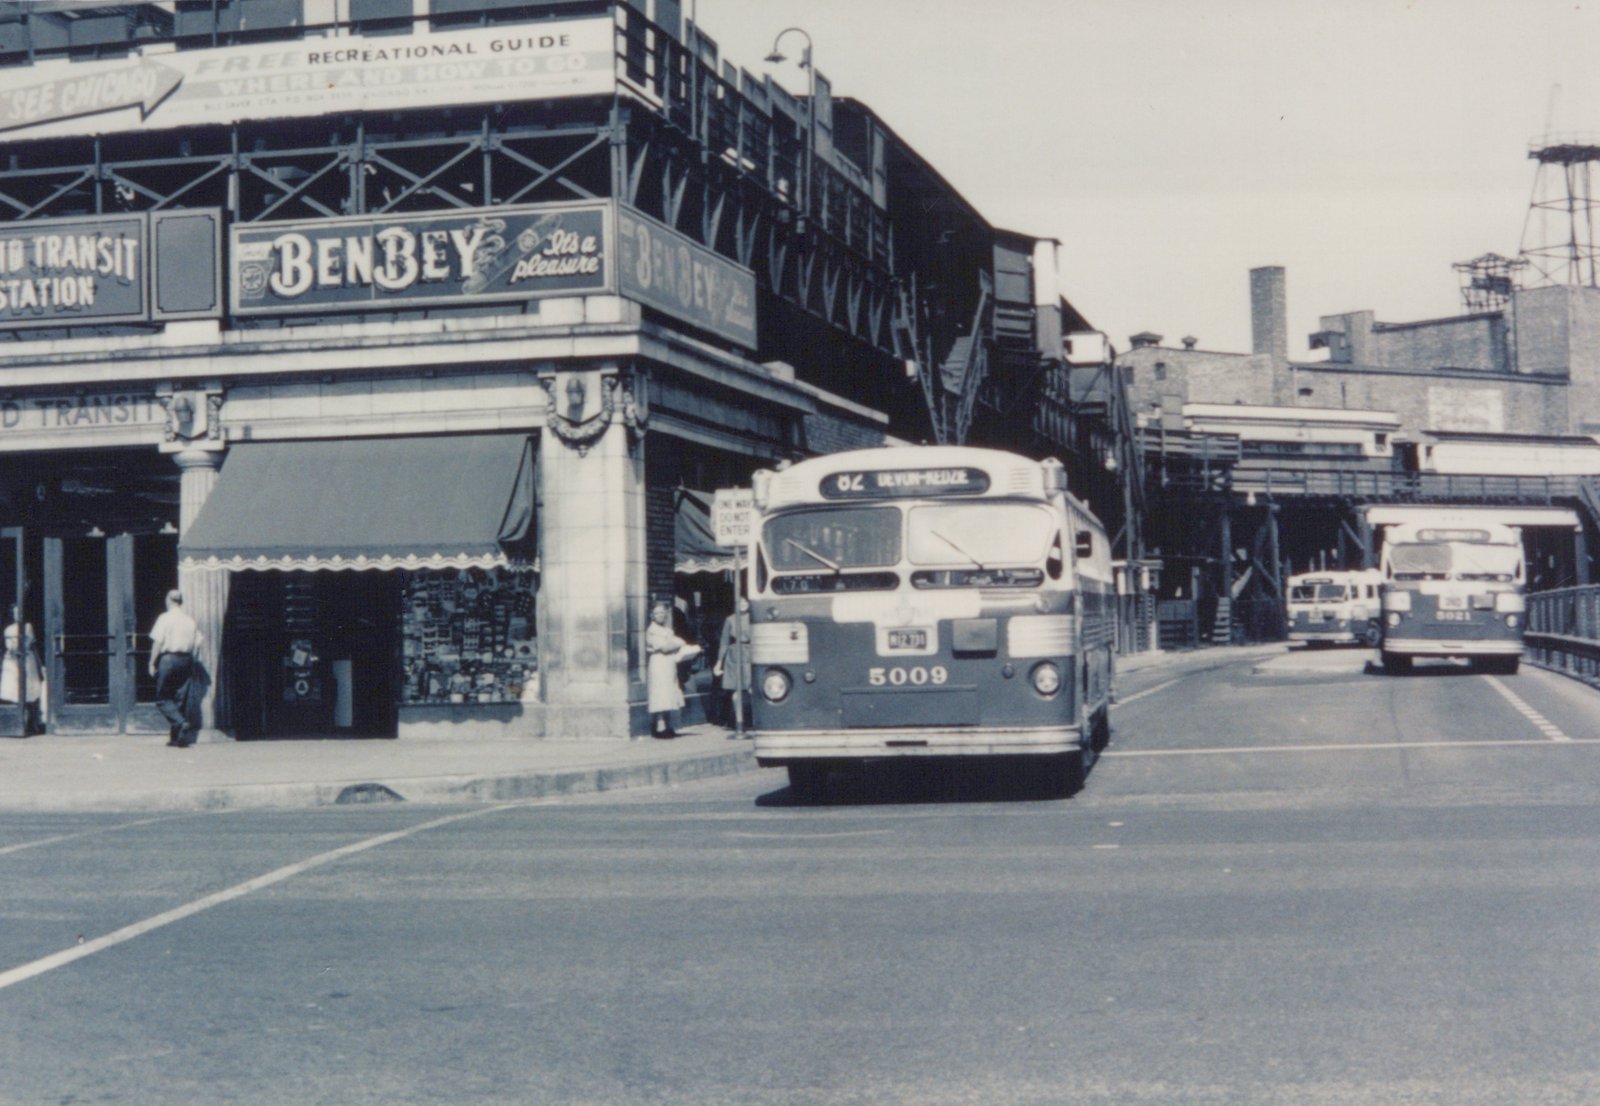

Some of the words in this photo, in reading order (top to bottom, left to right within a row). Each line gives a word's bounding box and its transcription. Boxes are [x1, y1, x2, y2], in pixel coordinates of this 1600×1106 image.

[195, 51, 302, 75] FREE
[307, 42, 477, 65] RECREATIONAL
[489, 33, 571, 54] GUIDE
[218, 71, 330, 96] WHERE
[337, 67, 402, 86] AND
[416, 61, 488, 82] HOW
[497, 58, 536, 76] TO
[546, 53, 588, 73] GO
[32, 234, 138, 281] TRANSIT
[543, 229, 579, 255] It's
[580, 234, 597, 253] a
[510, 255, 600, 284] pleasure
[0, 275, 95, 310] STATION
[35, 395, 156, 427] TRANSIT
[719, 524, 750, 536] ENTER
[869, 665, 948, 686] 5009
